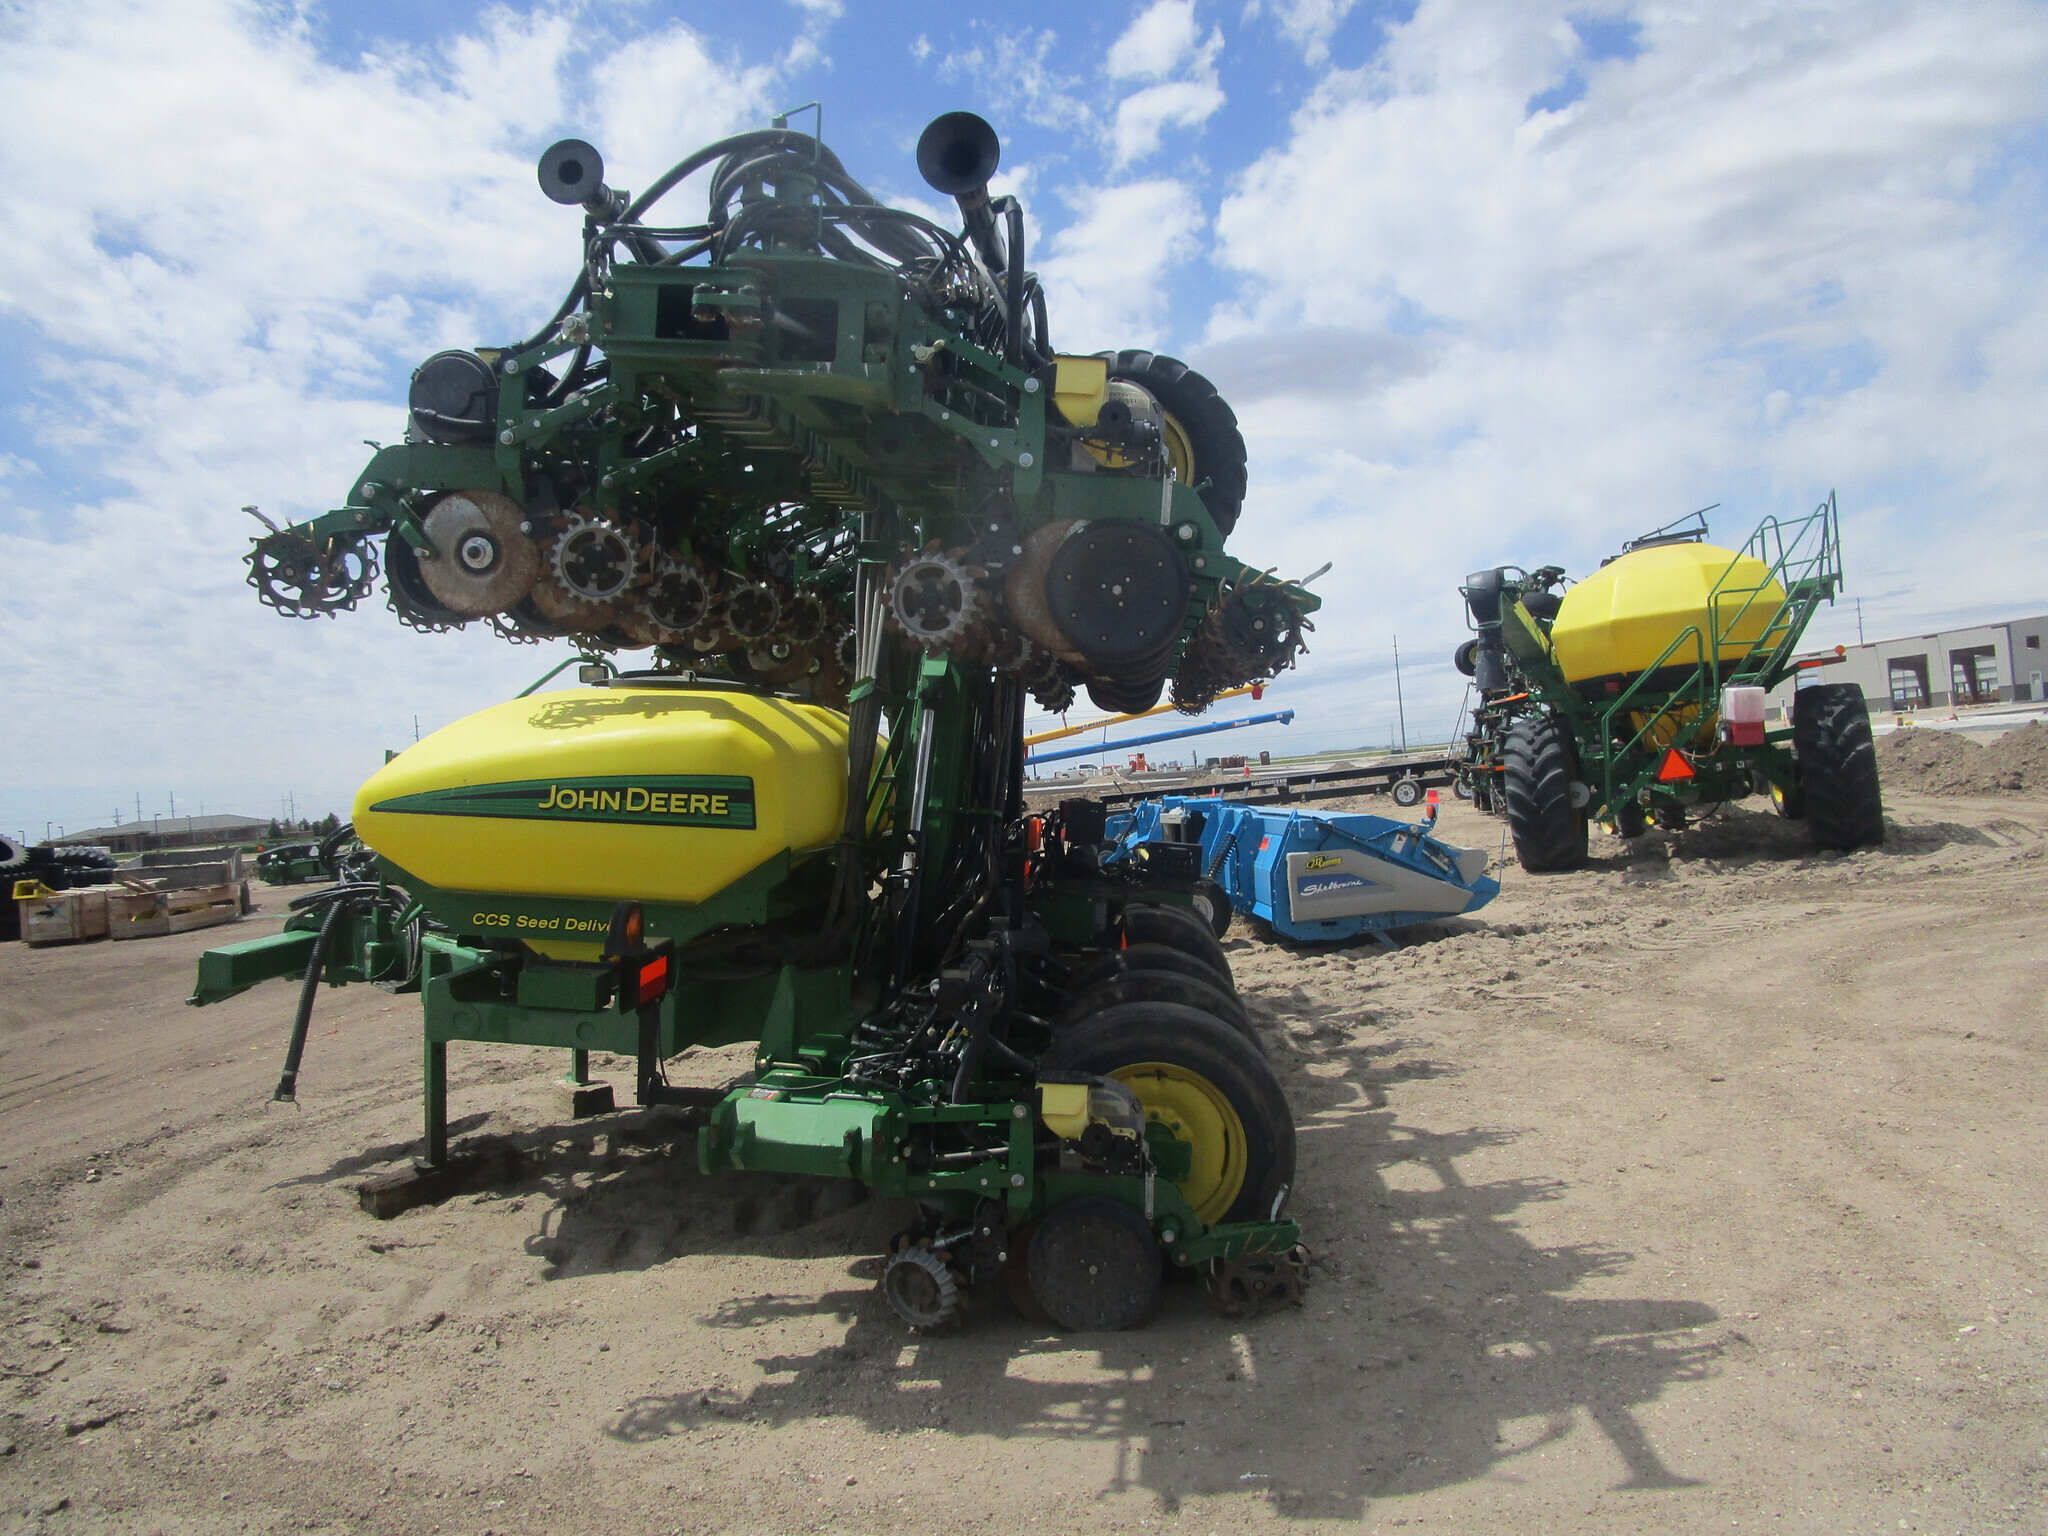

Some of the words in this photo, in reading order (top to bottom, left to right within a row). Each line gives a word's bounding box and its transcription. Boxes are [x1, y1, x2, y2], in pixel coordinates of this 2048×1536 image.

[538, 784, 621, 811] JOHN
[625, 787, 730, 815] DEERE
[1300, 880, 1363, 896] Shelbourne
[472, 912, 511, 927] CCS
[515, 915, 561, 930] Seed
